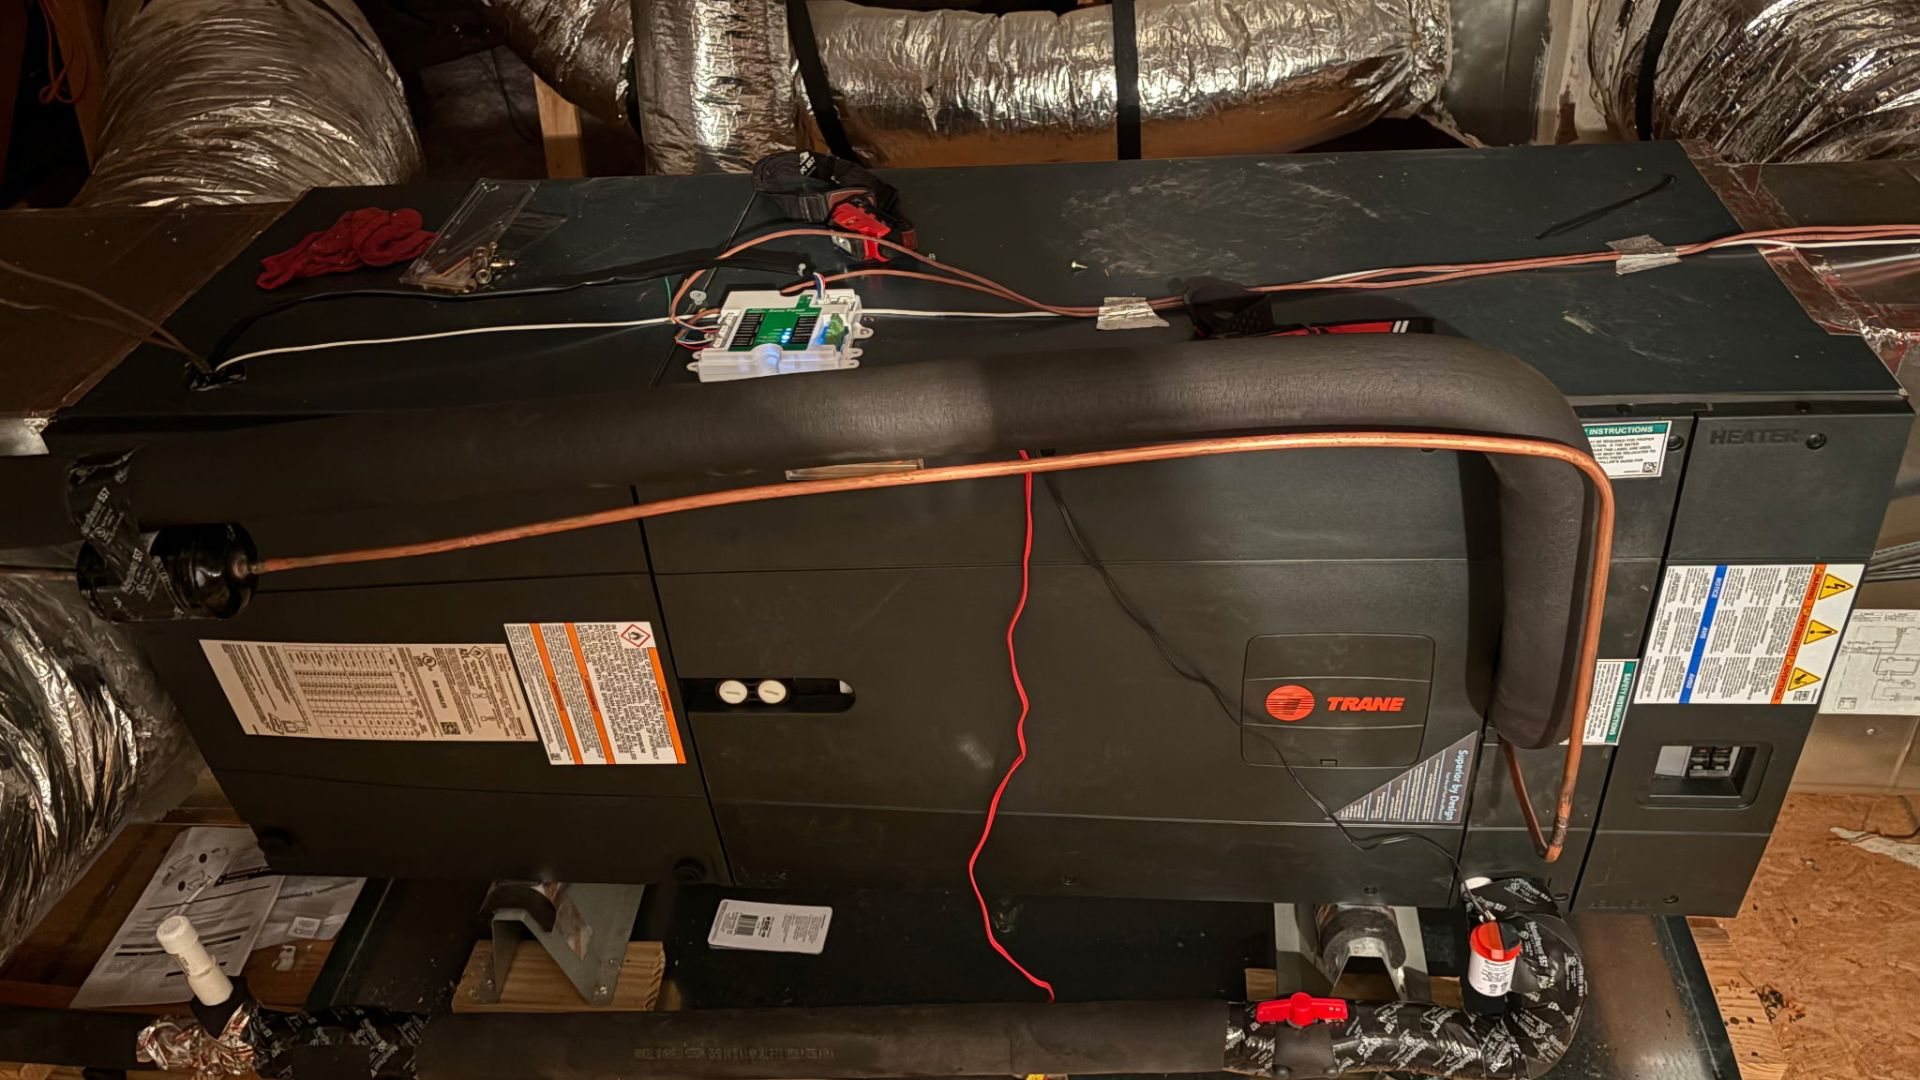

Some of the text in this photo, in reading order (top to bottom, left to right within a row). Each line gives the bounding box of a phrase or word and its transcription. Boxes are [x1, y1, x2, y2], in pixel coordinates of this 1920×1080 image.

[1589, 426, 1653, 436] INSTRUCTIONS
[1709, 429, 1801, 444] HEATER
[1711, 577, 1722, 597] NOTICE
[1327, 696, 1405, 711] TRANE
[1608, 673, 1631, 734] SAFETY INSTRUCTIONS
[1454, 750, 1468, 782] Superior
[1449, 784, 1462, 794] by
[1444, 796, 1460, 820] Design
[1537, 954, 1549, 968] 557
